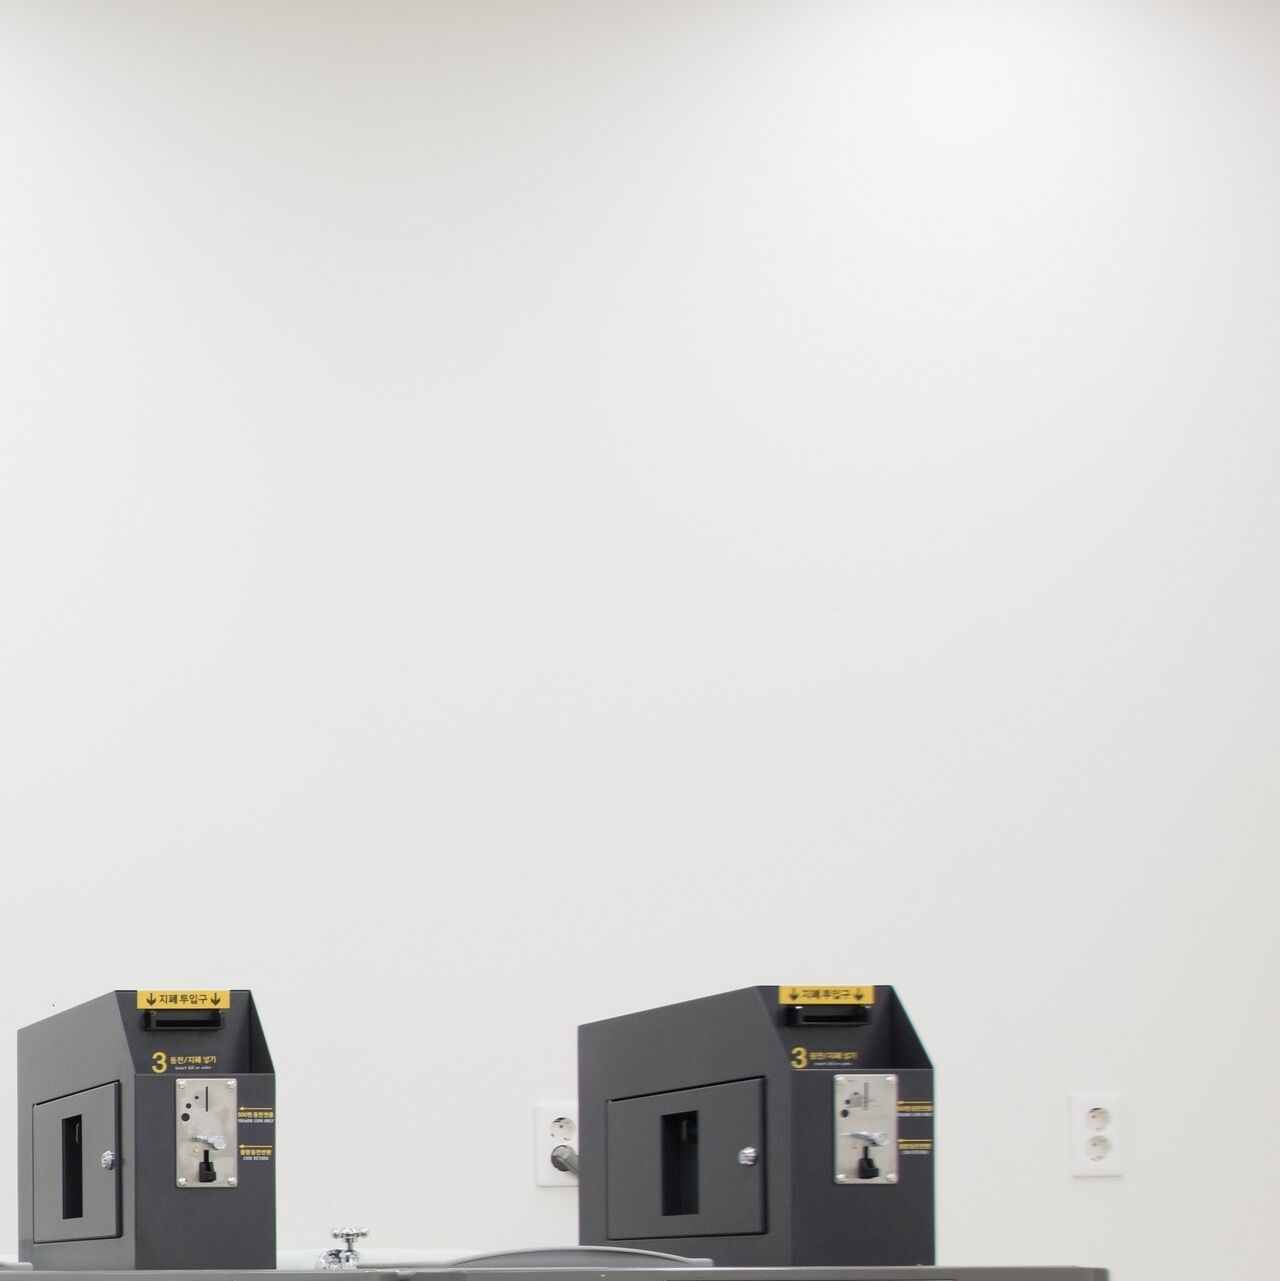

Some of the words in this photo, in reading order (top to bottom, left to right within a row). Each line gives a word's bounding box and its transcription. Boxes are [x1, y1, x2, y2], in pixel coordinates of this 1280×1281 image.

[158, 994, 178, 1004] 지폐
[179, 994, 208, 1004] 투입구
[152, 1052, 168, 1074] 3
[170, 1056, 202, 1064] 동전/지폐
[203, 1056, 216, 1064] 넣기
[791, 1046, 808, 1068] 3
